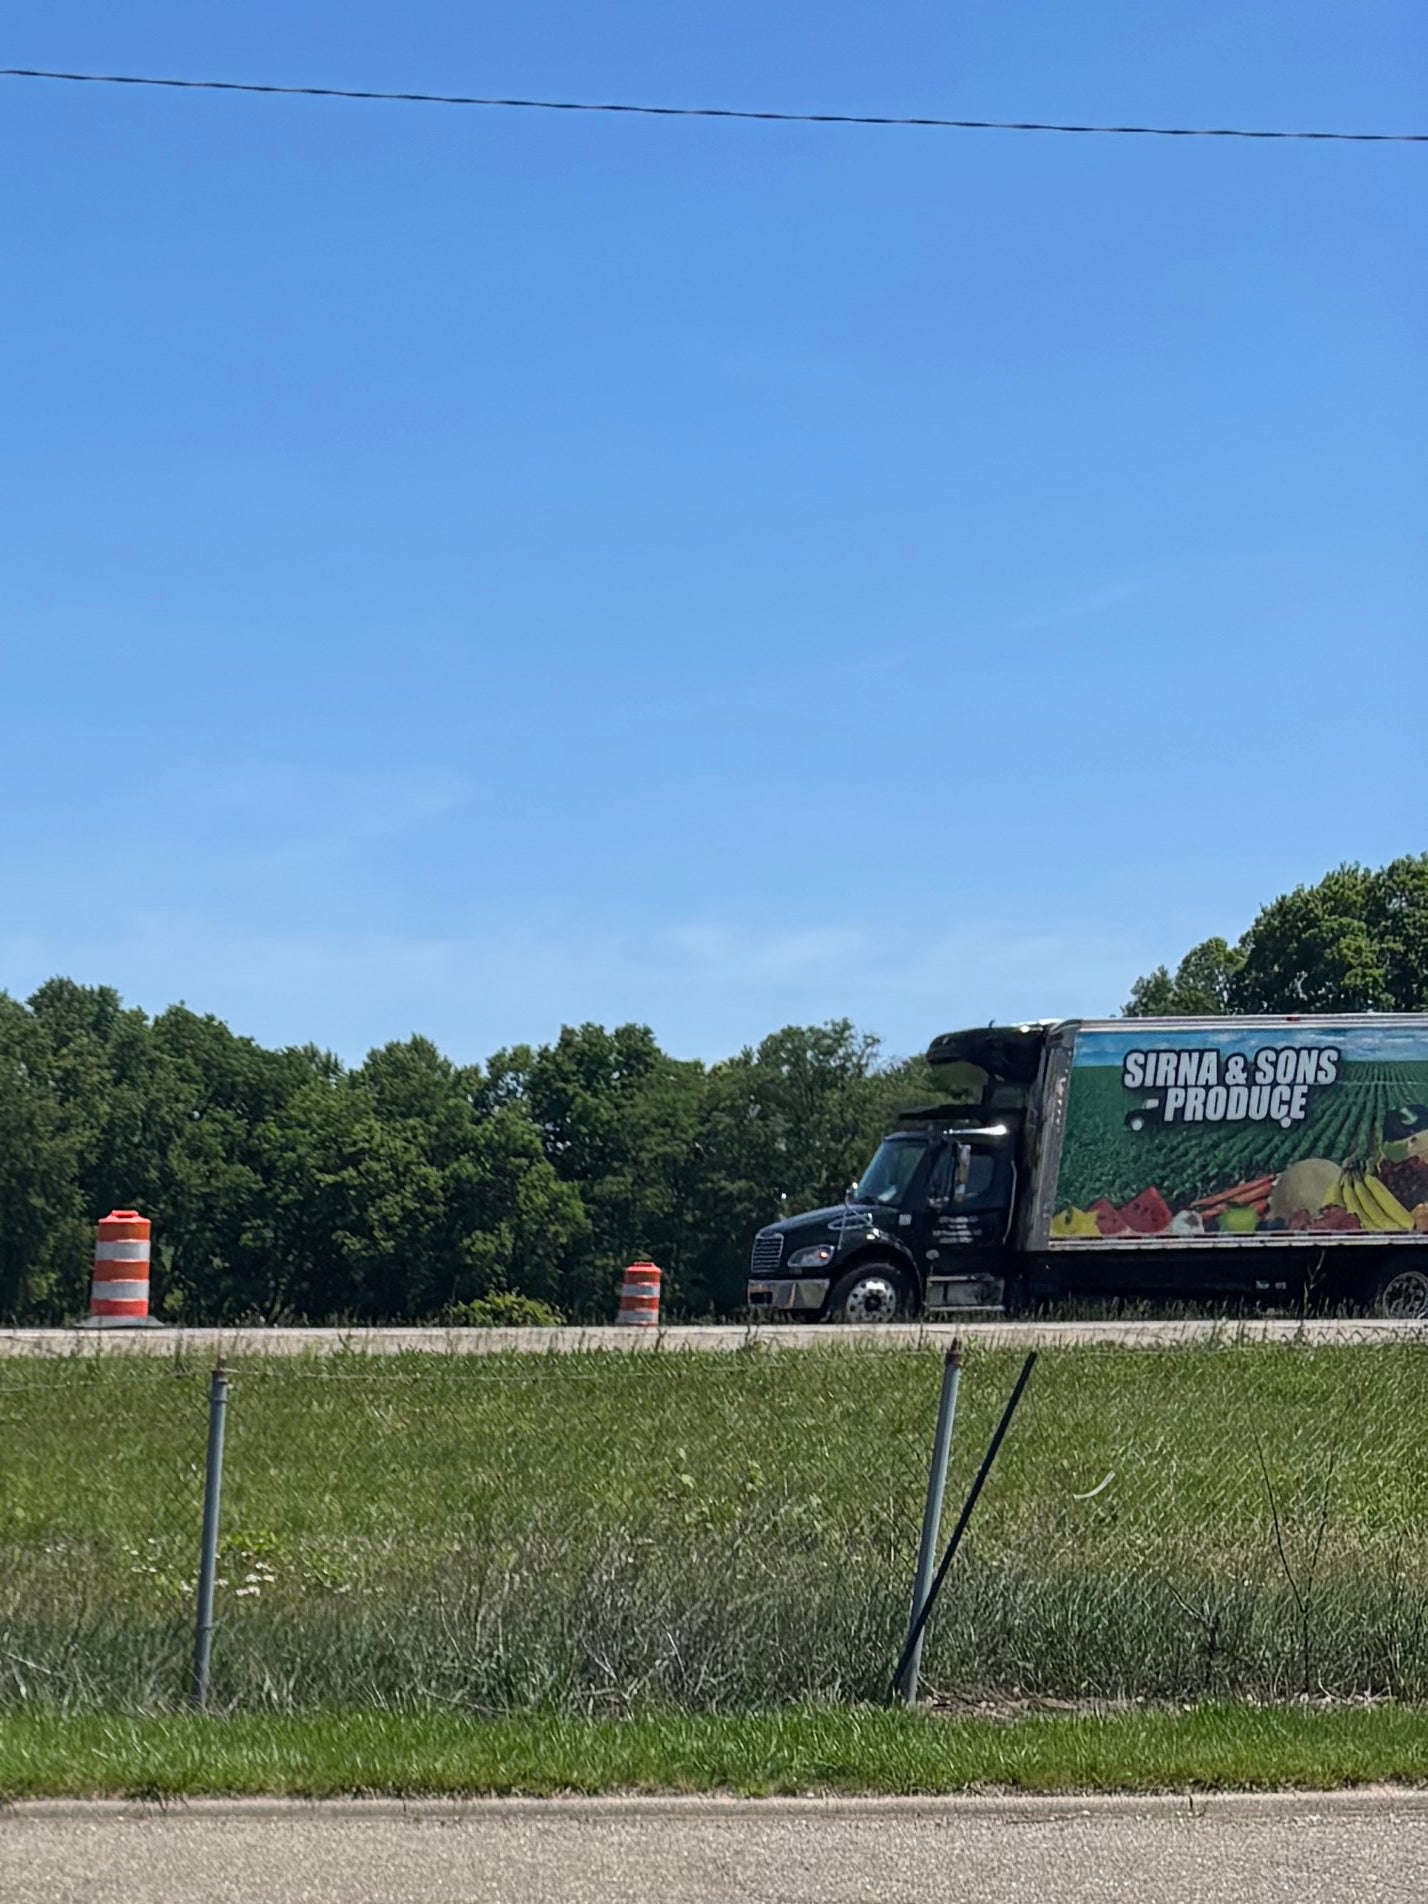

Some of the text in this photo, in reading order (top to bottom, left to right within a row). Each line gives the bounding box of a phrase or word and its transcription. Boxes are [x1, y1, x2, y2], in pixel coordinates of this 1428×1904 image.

[1123, 1049, 1337, 1088] SIRNA & SONS
[1163, 1085, 1308, 1122] PRODUCE
